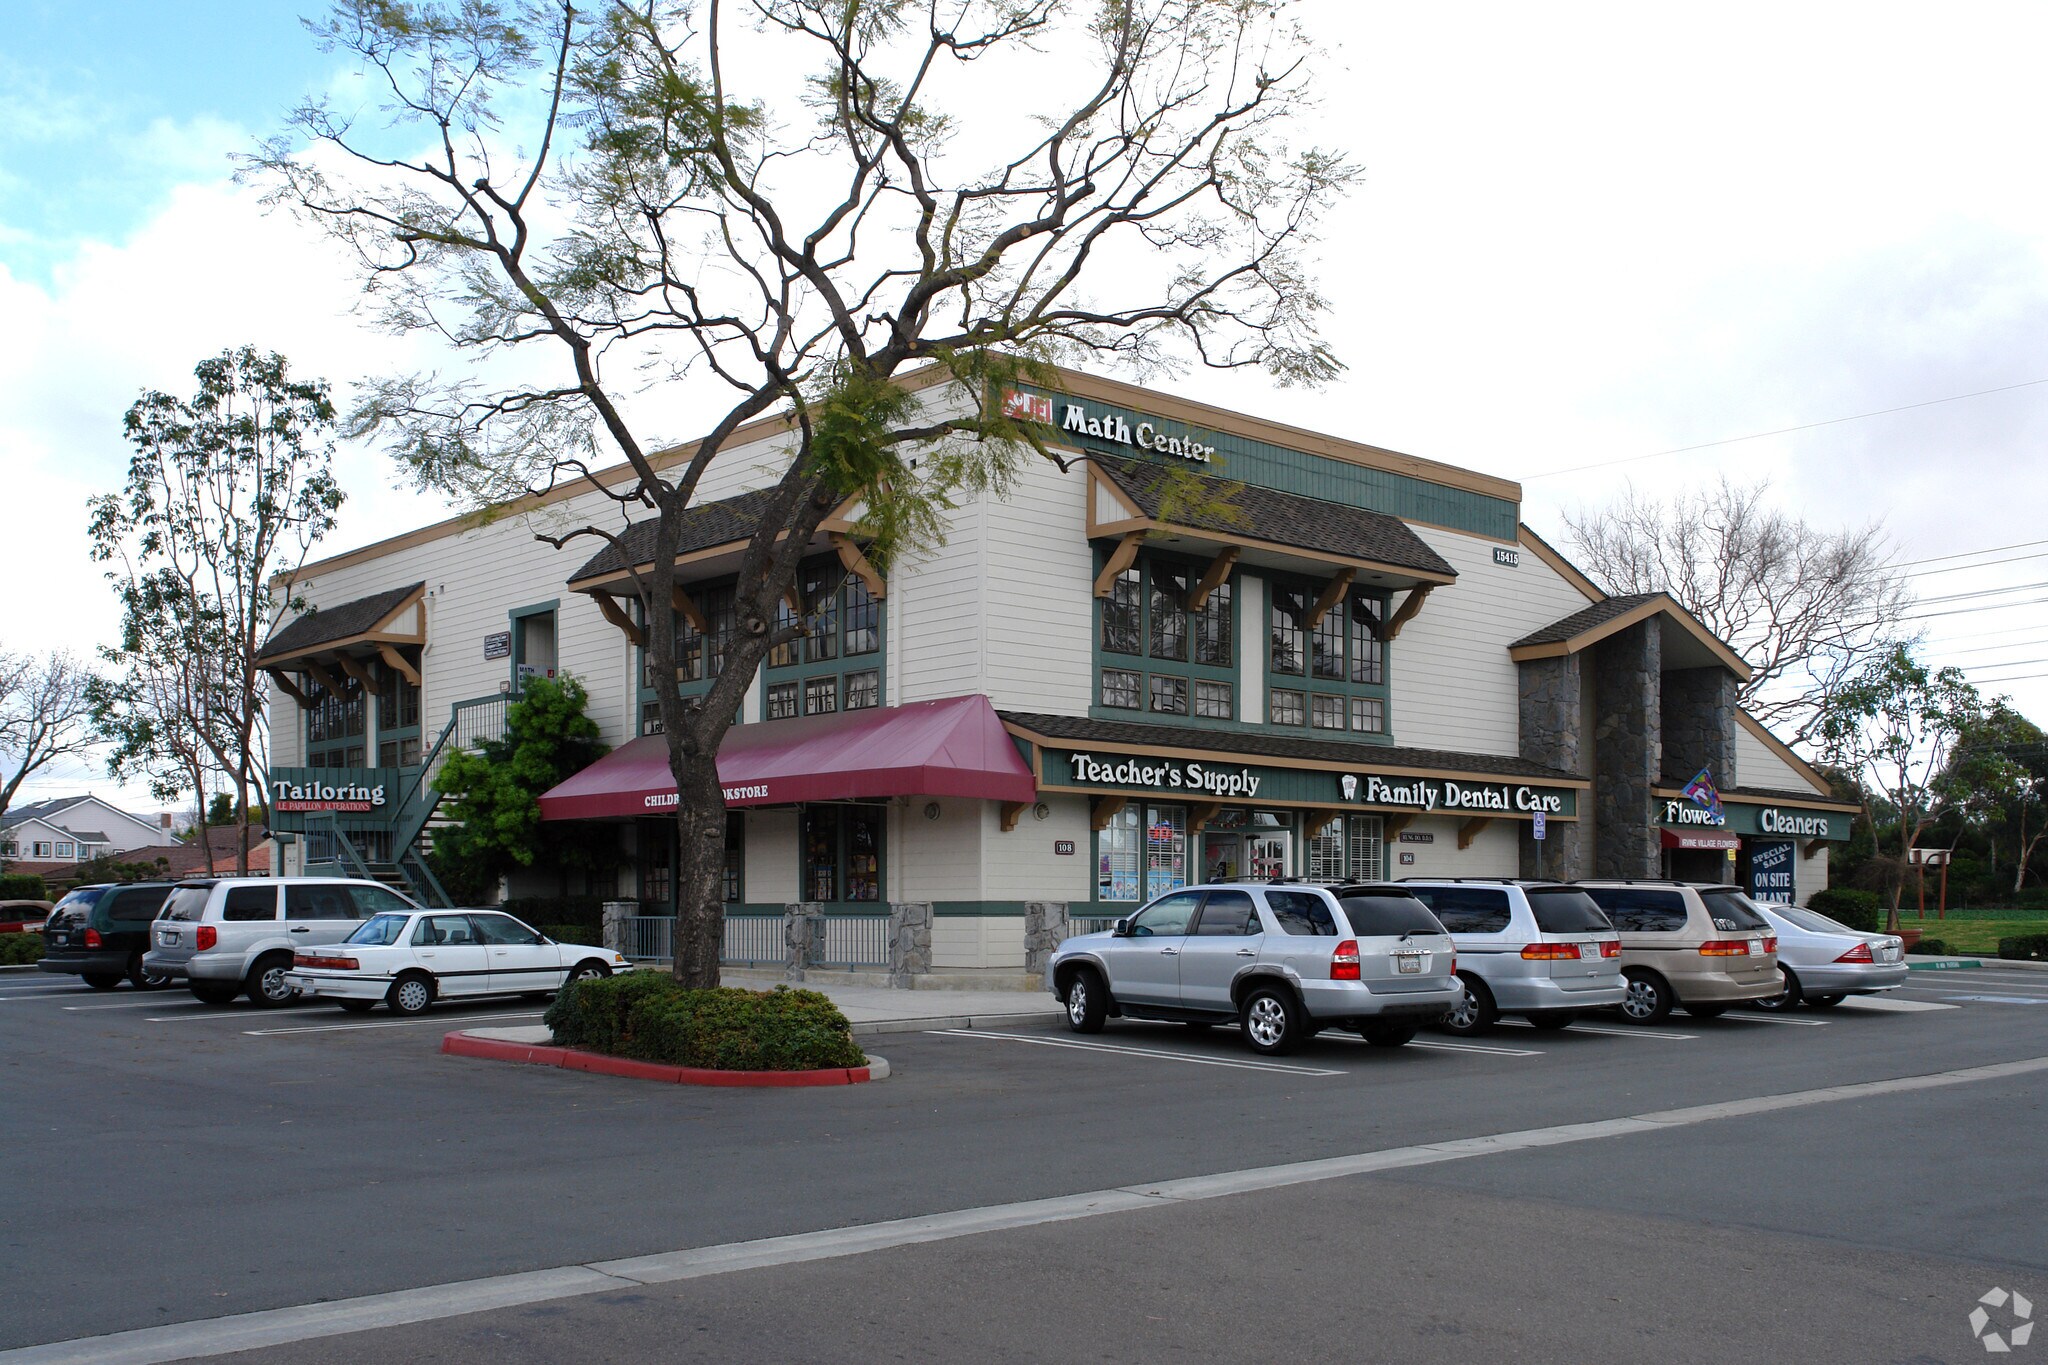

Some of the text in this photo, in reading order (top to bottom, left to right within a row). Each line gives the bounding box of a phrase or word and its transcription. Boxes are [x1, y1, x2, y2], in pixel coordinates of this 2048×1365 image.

[1063, 405, 1215, 462] Math Center
[1496, 550, 1518, 564] 15415
[1071, 753, 1260, 797] Teacher's Supply
[273, 781, 386, 805] Tailoring
[644, 793, 680, 807] CHILDR
[1366, 776, 1562, 812] Family Dental Care
[278, 802, 370, 811] LE PAPILLON ALTERATIONS
[1666, 801, 1726, 825] Flowe
[1761, 808, 1828, 836] Cleaners
[1058, 844, 1072, 852] 108
[1697, 839, 1716, 848] VILLAGE
[1717, 840, 1738, 848] FLOWERS
[1752, 843, 1791, 864] SPECIAL
[1762, 853, 1787, 869] SALE
[1755, 872, 1790, 887] ON SITE
